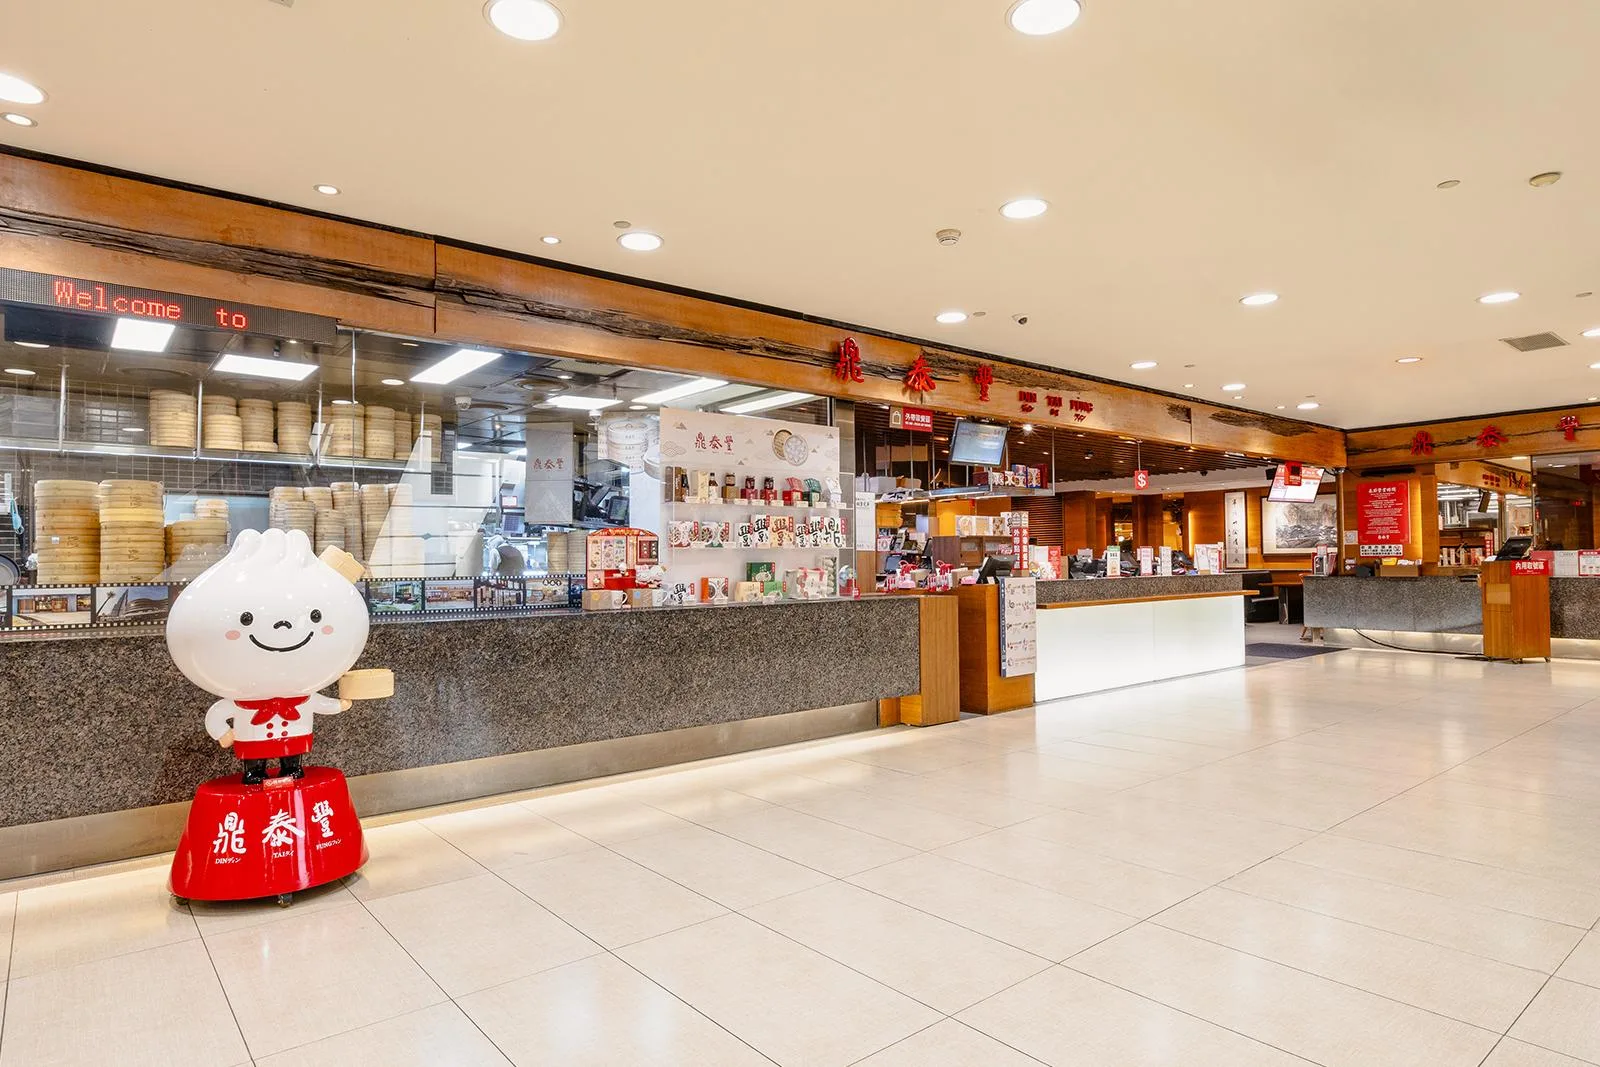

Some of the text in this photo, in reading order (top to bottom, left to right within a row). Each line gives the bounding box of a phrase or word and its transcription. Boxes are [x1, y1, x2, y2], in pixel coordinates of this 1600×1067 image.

[54, 280, 248, 330] Welcome to
[1137, 472, 1147, 488] $
[212, 799, 335, 855] 鼎泰豐
